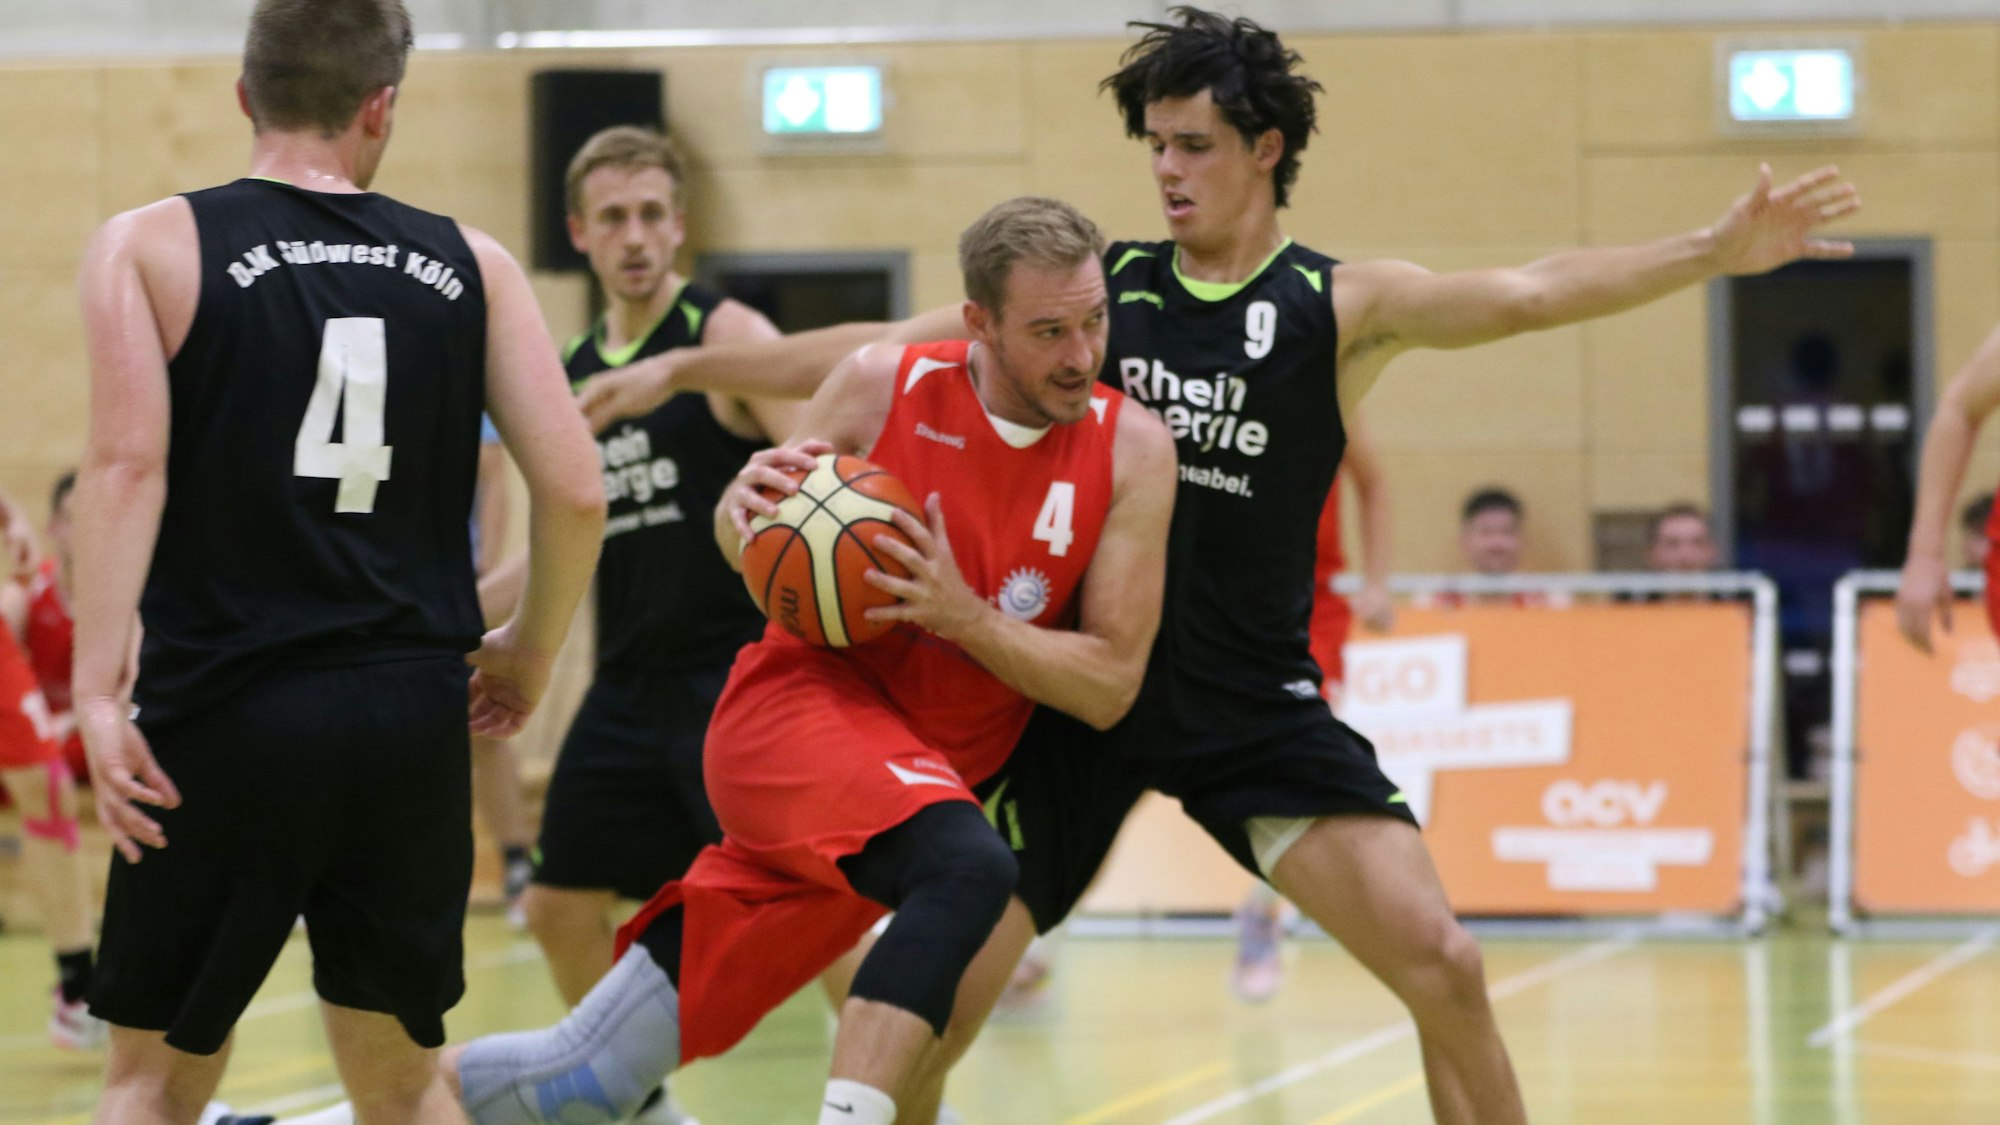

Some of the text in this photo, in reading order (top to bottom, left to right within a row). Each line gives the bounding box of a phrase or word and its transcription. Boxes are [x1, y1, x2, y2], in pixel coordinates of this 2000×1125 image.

[226, 240, 465, 301] DJK Südwest Köln
[1244, 300, 1278, 360] 9
[293, 317, 393, 513] 4
[1119, 357, 1247, 412] Rhein
[1032, 480, 1075, 557] 4
